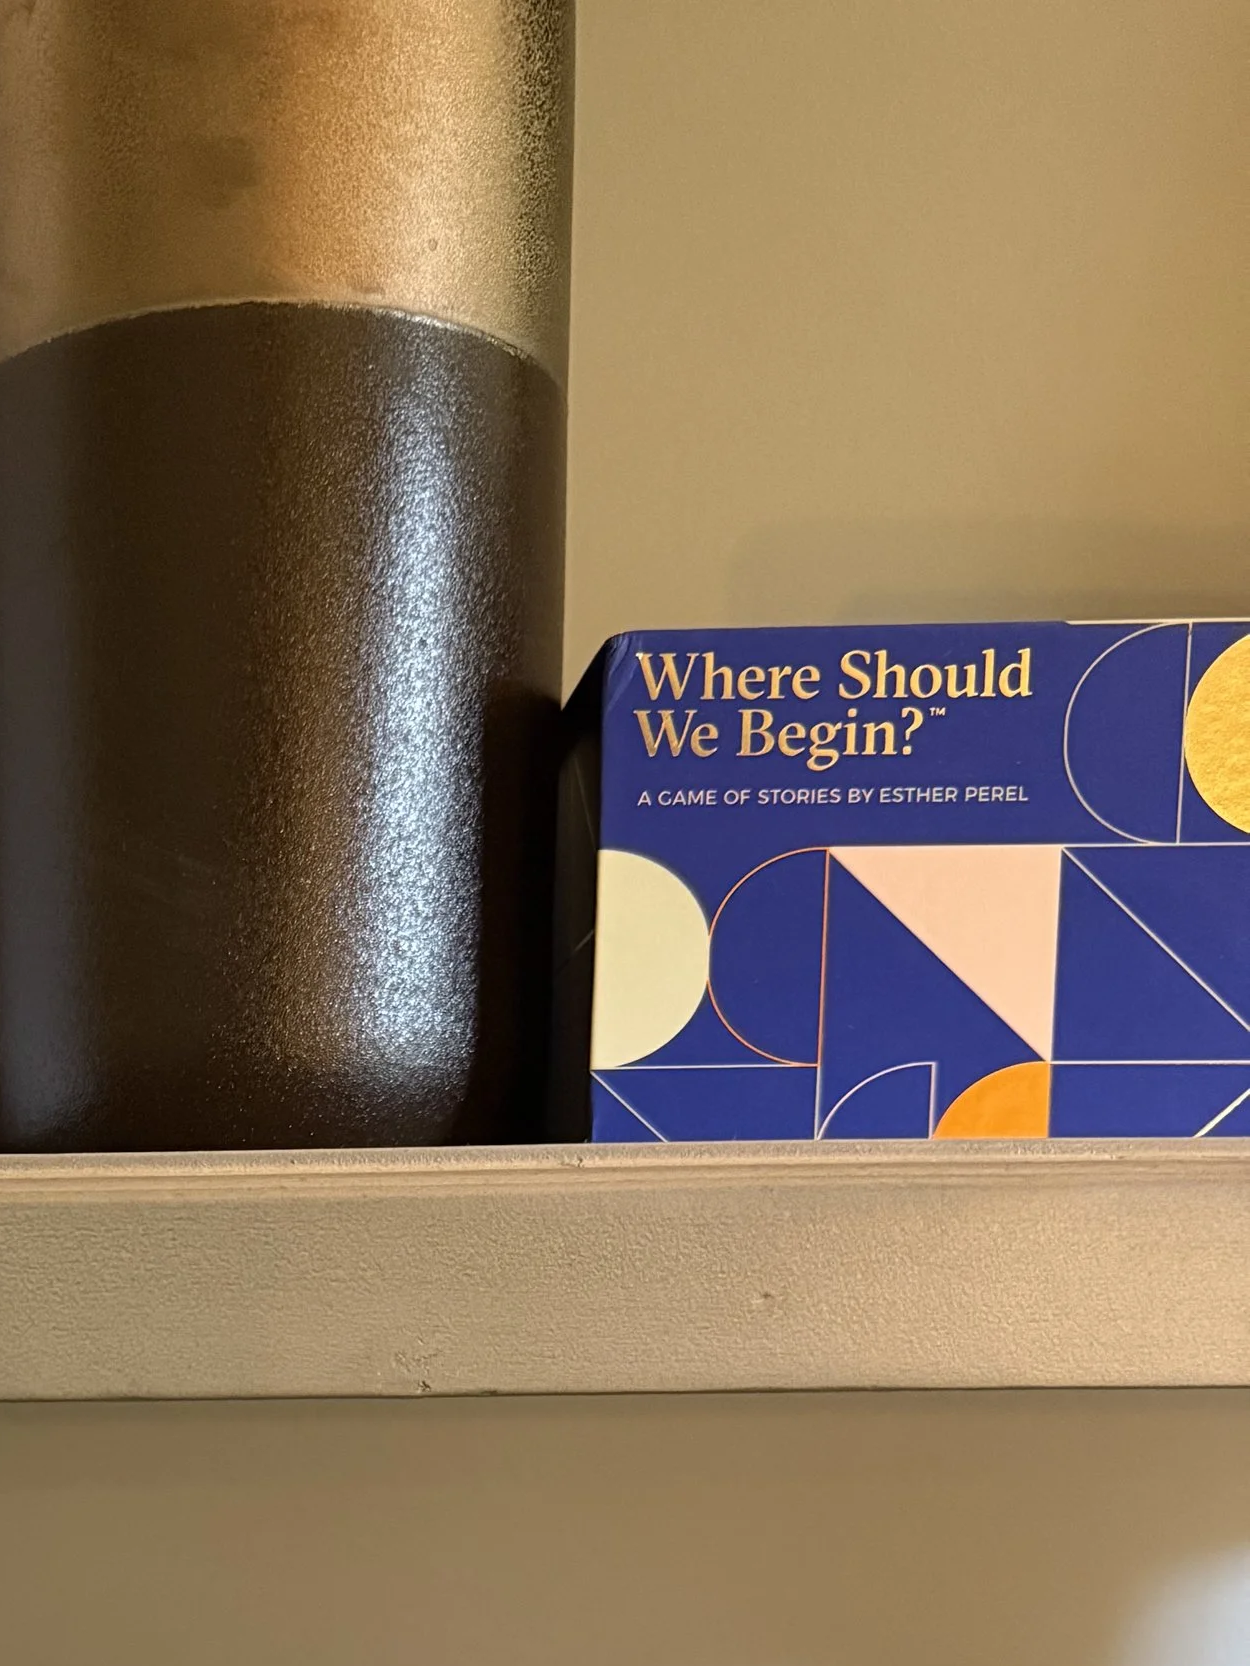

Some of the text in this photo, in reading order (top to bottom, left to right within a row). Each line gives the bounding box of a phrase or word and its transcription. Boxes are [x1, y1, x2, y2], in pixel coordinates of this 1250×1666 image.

[637, 648, 1031, 702] Where Should
[633, 708, 718, 758] We
[637, 785, 1028, 806] A GAME OF STORIES BY ESTHER PEREL
